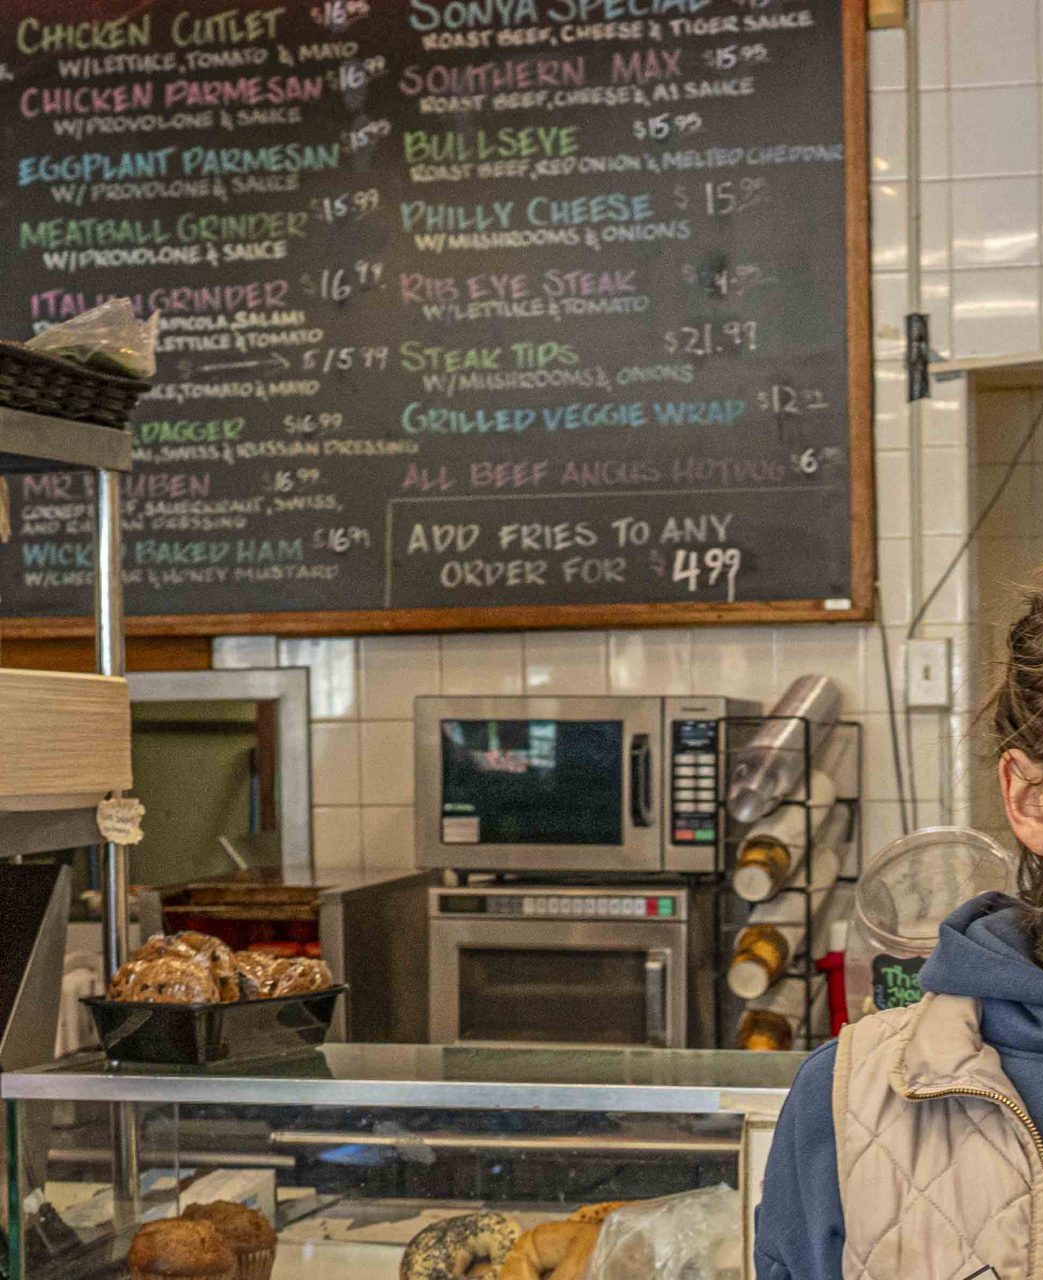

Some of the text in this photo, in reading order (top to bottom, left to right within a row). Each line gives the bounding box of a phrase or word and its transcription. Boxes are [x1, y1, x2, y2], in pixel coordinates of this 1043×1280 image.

[17, 15, 150, 54] CHICKEN
[171, 7, 287, 47] CUTLET
[409, 0, 538, 31] SONYA
[421, 30, 492, 50] ROAST
[560, 21, 643, 43] CHEESE
[668, 15, 740, 37] TIGER
[743, 10, 814, 32] SAUCE
[187, 48, 268, 68] TOMATO
[298, 41, 359, 62] MAYO
[400, 56, 586, 96] SOUTHERN
[611, 49, 682, 85] MAX
[20, 83, 152, 118] CHICKEN
[164, 76, 323, 107] PARMESAN
[419, 95, 486, 113] ROAST
[554, 86, 633, 106] CHEESE
[684, 77, 755, 99] SAUCE
[236, 107, 301, 126] SAUCE
[403, 127, 578, 163] BULLSEYE
[18, 147, 176, 186] EGGPLANT
[182, 143, 340, 176] PARMESAN
[410, 162, 472, 182] ROAST
[579, 154, 642, 174] ONION
[663, 148, 744, 170] MELTED
[231, 174, 299, 193] SAUCE
[401, 201, 516, 232] PHILLY
[527, 194, 655, 226] CHEESE
[19, 217, 172, 249] MEATBALL
[177, 211, 308, 242] GRINDER
[602, 220, 690, 242] ONIONS
[223, 239, 288, 261] SAUCE
[149, 280, 290, 313] GRINDER
[401, 269, 638, 303] RIB EYE STEAK
[562, 295, 649, 314] TOMATO
[248, 328, 324, 346] TOMATO
[401, 340, 501, 371] STEAK
[510, 341, 578, 369] TIPS
[183, 383, 252, 398] TOMATO
[269, 379, 321, 396] MAYO
[616, 363, 694, 385] ONIONS
[139, 417, 246, 441] DAGGER
[402, 401, 537, 434] GRILLED
[542, 402, 648, 432] VEGGIE
[653, 400, 745, 427] WRAP
[22, 474, 81, 499] MR
[403, 462, 455, 491] ALL
[470, 459, 550, 487] BEEF
[406, 513, 733, 554] ADD FRIES TO ANY
[135, 539, 230, 564] BAKED
[236, 538, 303, 562] HAM
[440, 558, 548, 588] ORDER
[563, 556, 627, 584] FOR
